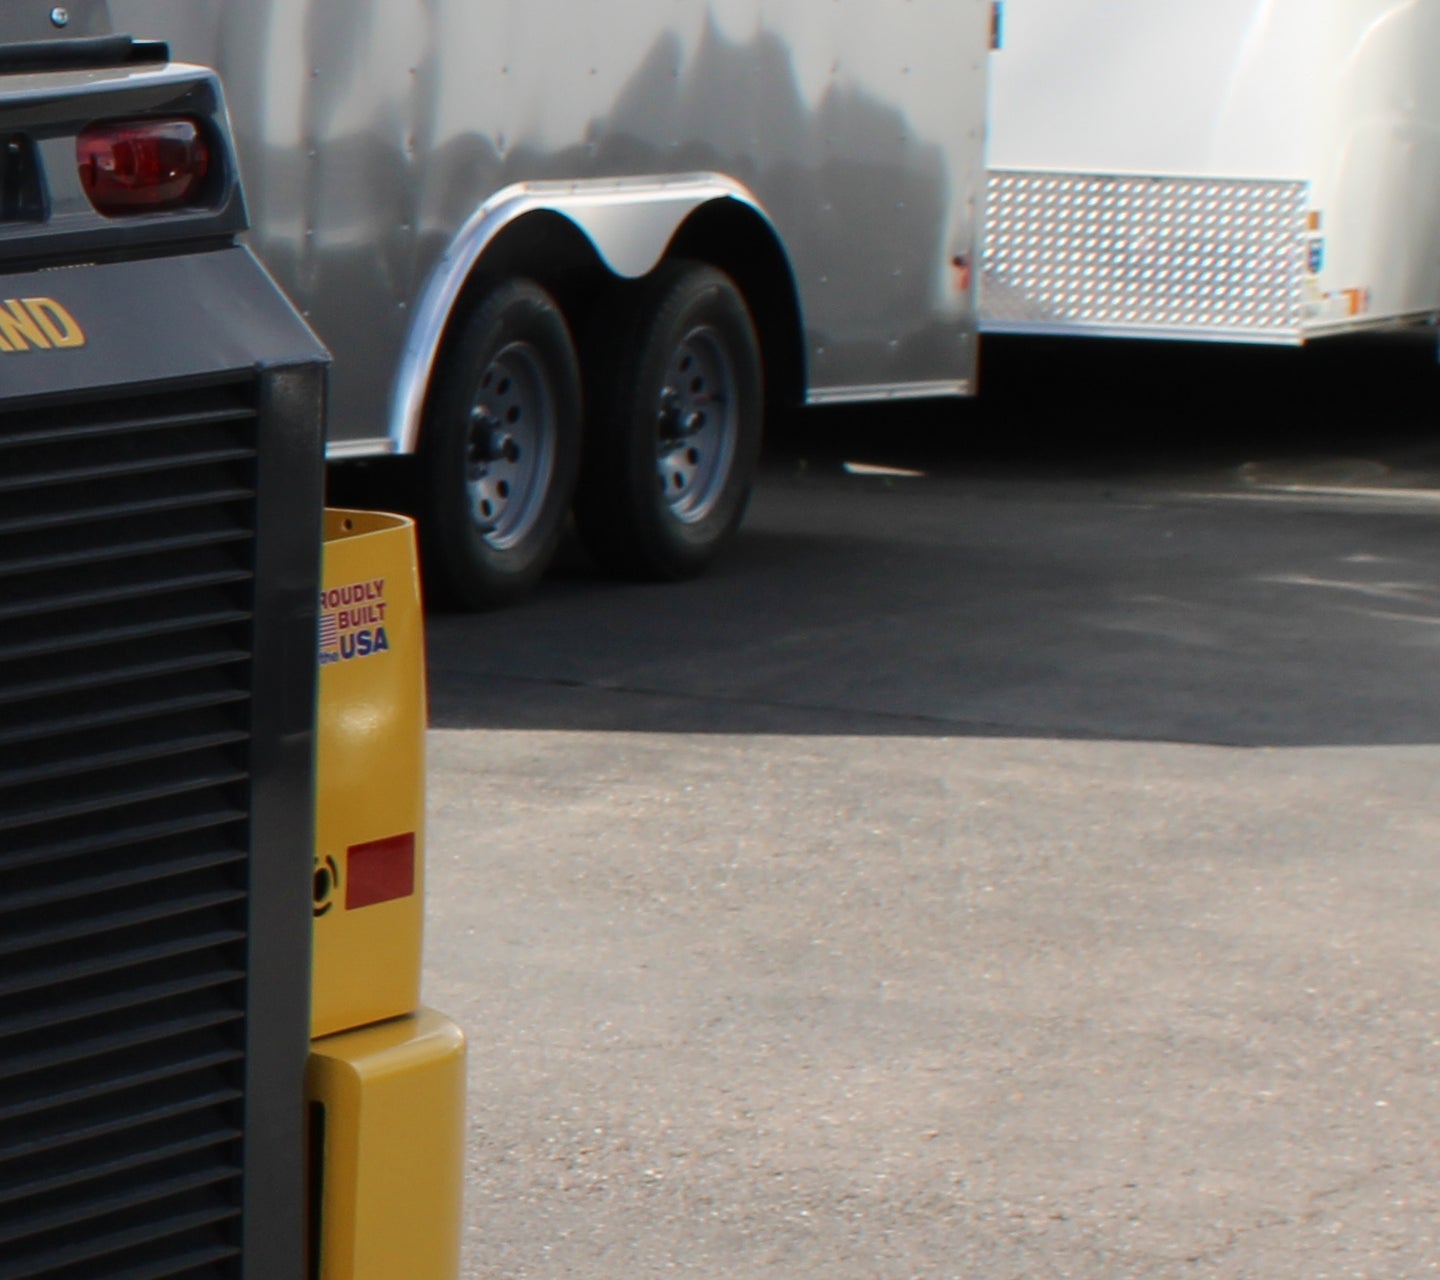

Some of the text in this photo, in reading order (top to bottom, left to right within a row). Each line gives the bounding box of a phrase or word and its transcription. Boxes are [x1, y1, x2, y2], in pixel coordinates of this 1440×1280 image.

[320, 579, 384, 609] ROUDLY
[339, 603, 386, 629] BUILT
[340, 627, 389, 659] USA
